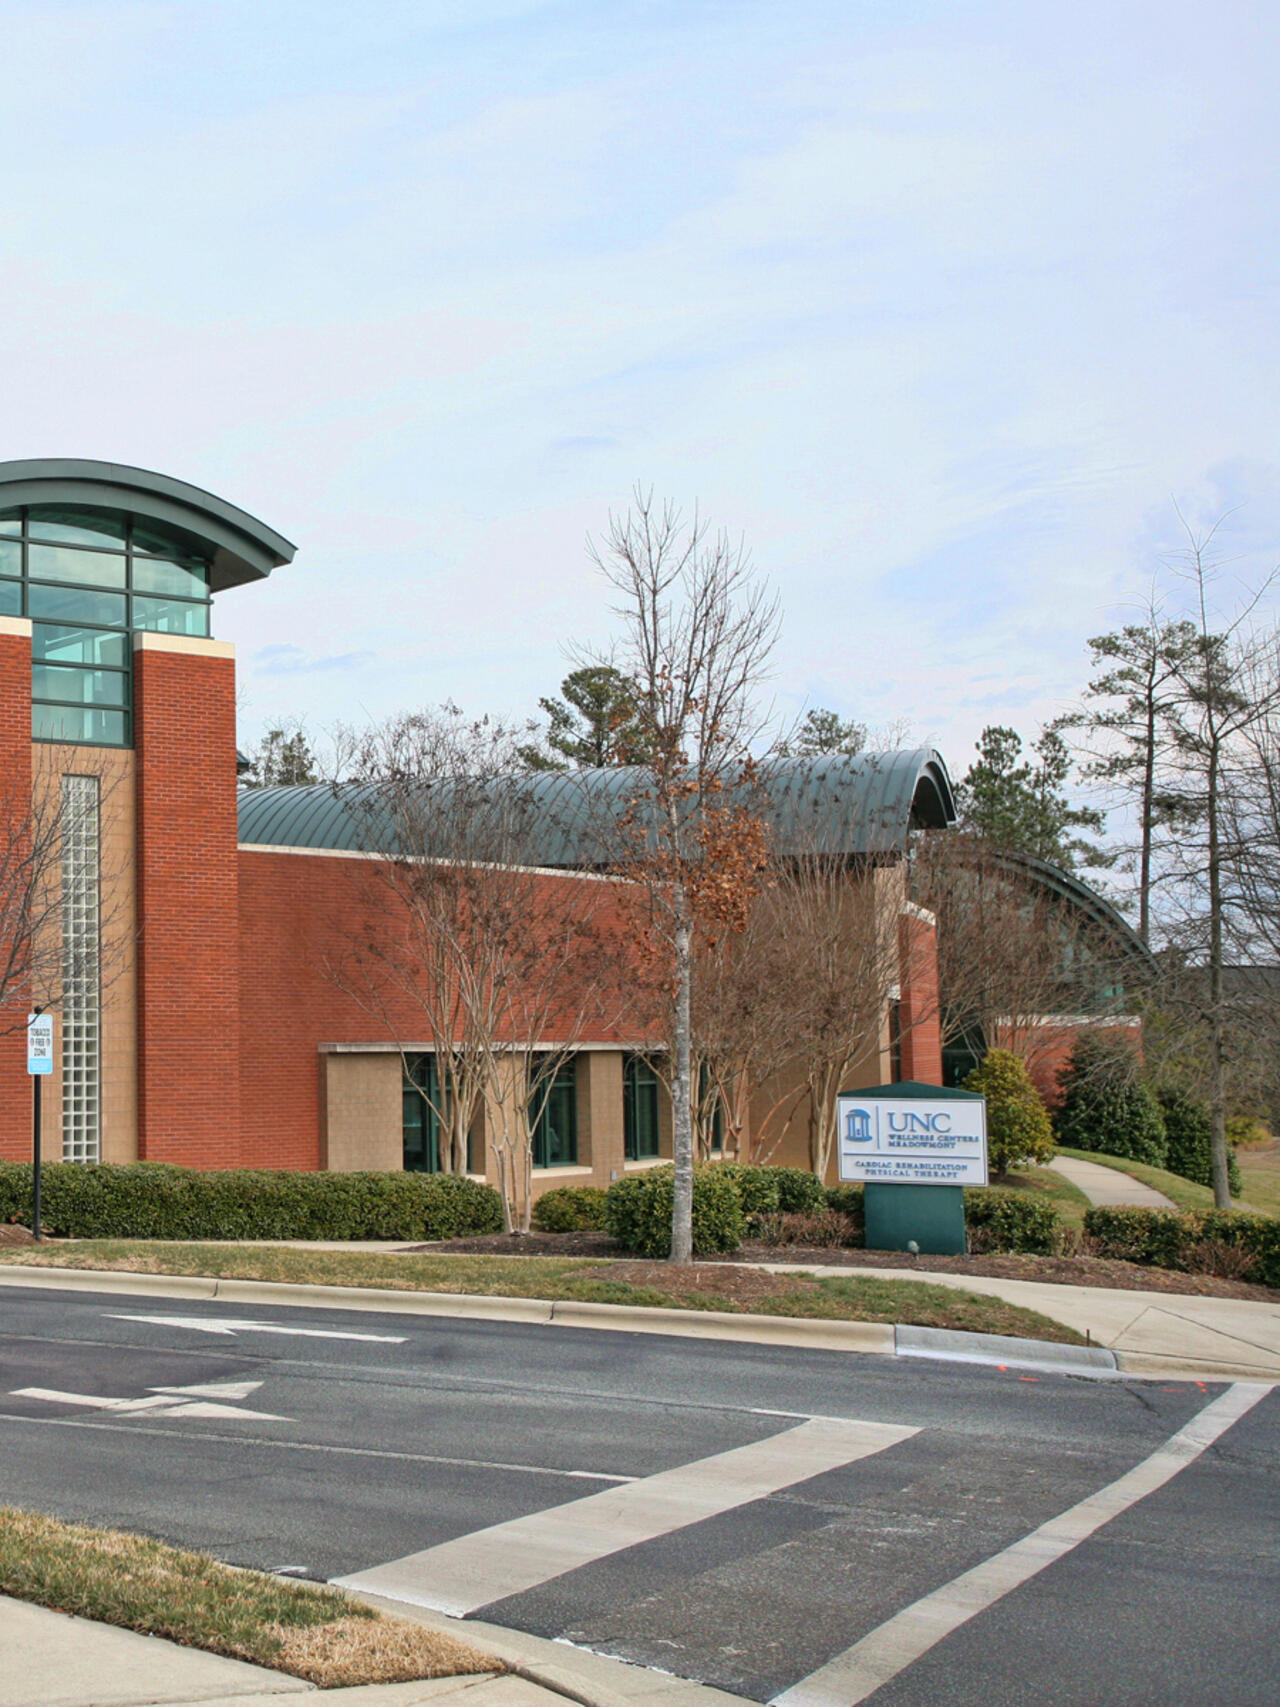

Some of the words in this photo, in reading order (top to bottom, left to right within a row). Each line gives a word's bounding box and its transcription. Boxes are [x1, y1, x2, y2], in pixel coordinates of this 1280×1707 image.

[887, 1112, 952, 1133] UNC
[888, 1134, 934, 1142] WELLNESS
[888, 1141, 956, 1149] MEADOWMONT
[855, 1160, 892, 1169] CARDIAC
[896, 1162, 968, 1171] REHABILITATION
[865, 1169, 910, 1177] PHYSICAL
